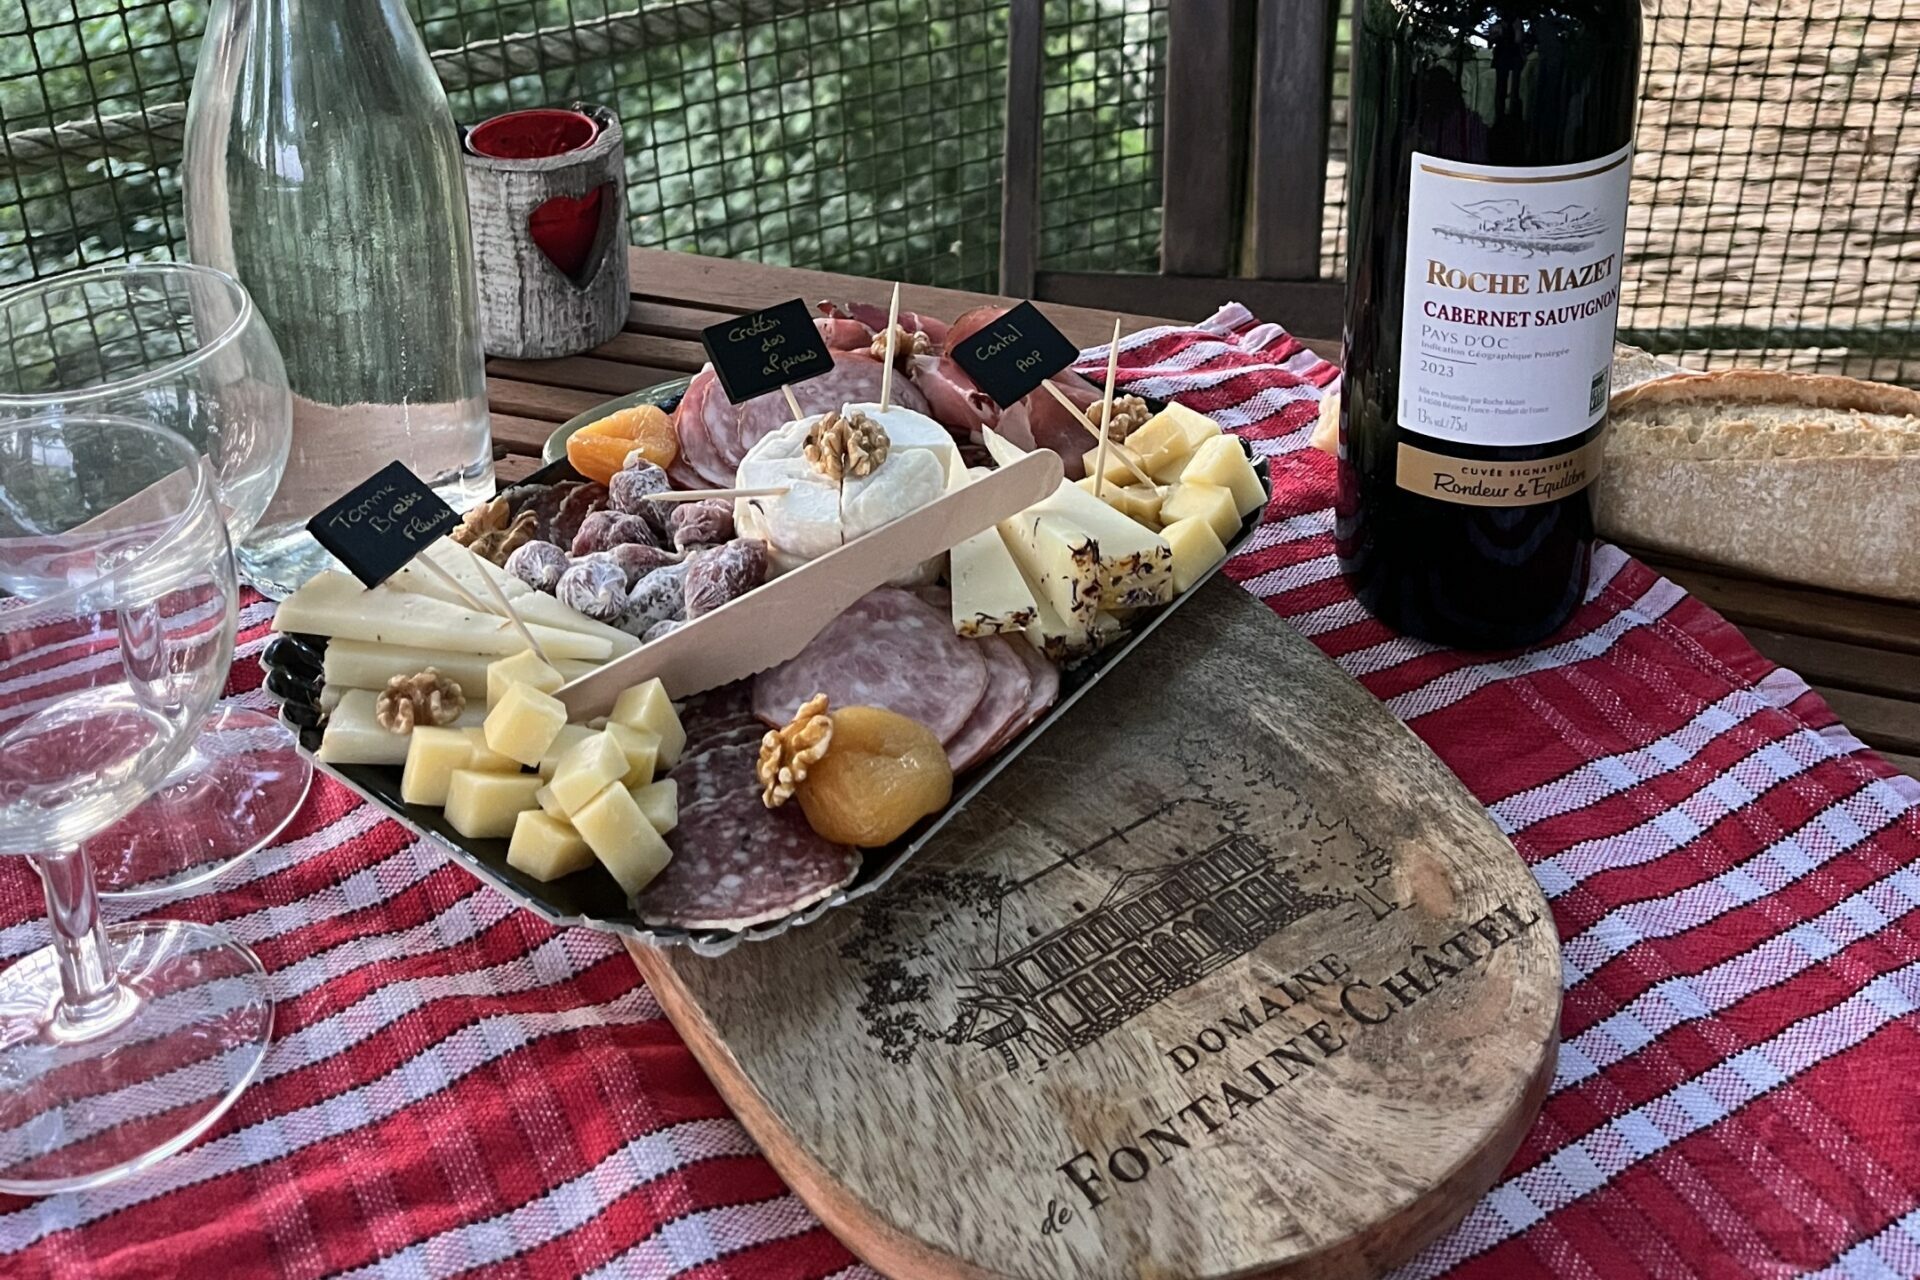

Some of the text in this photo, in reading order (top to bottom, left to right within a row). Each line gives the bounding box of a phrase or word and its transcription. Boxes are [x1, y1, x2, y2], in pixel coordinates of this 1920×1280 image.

[1426, 252, 1616, 295] ROCHE MAZET
[1423, 284, 1618, 328] CABERNET SAUVIGNON
[1421, 324, 1510, 350] PAYS D'OC
[1015, 349, 1043, 373] AOP
[1420, 340, 1466, 355] Indication
[1467, 349, 1533, 361] Géographique
[1420, 359, 1455, 379] 2023
[1461, 466, 1503, 477] CUVÉE
[1433, 472, 1510, 498] Rondeur
[1514, 483, 1528, 497] &
[1165, 952, 1352, 1075] DOMAINE
[1040, 902, 1541, 1237] de FONTAINE CHÂTEL
